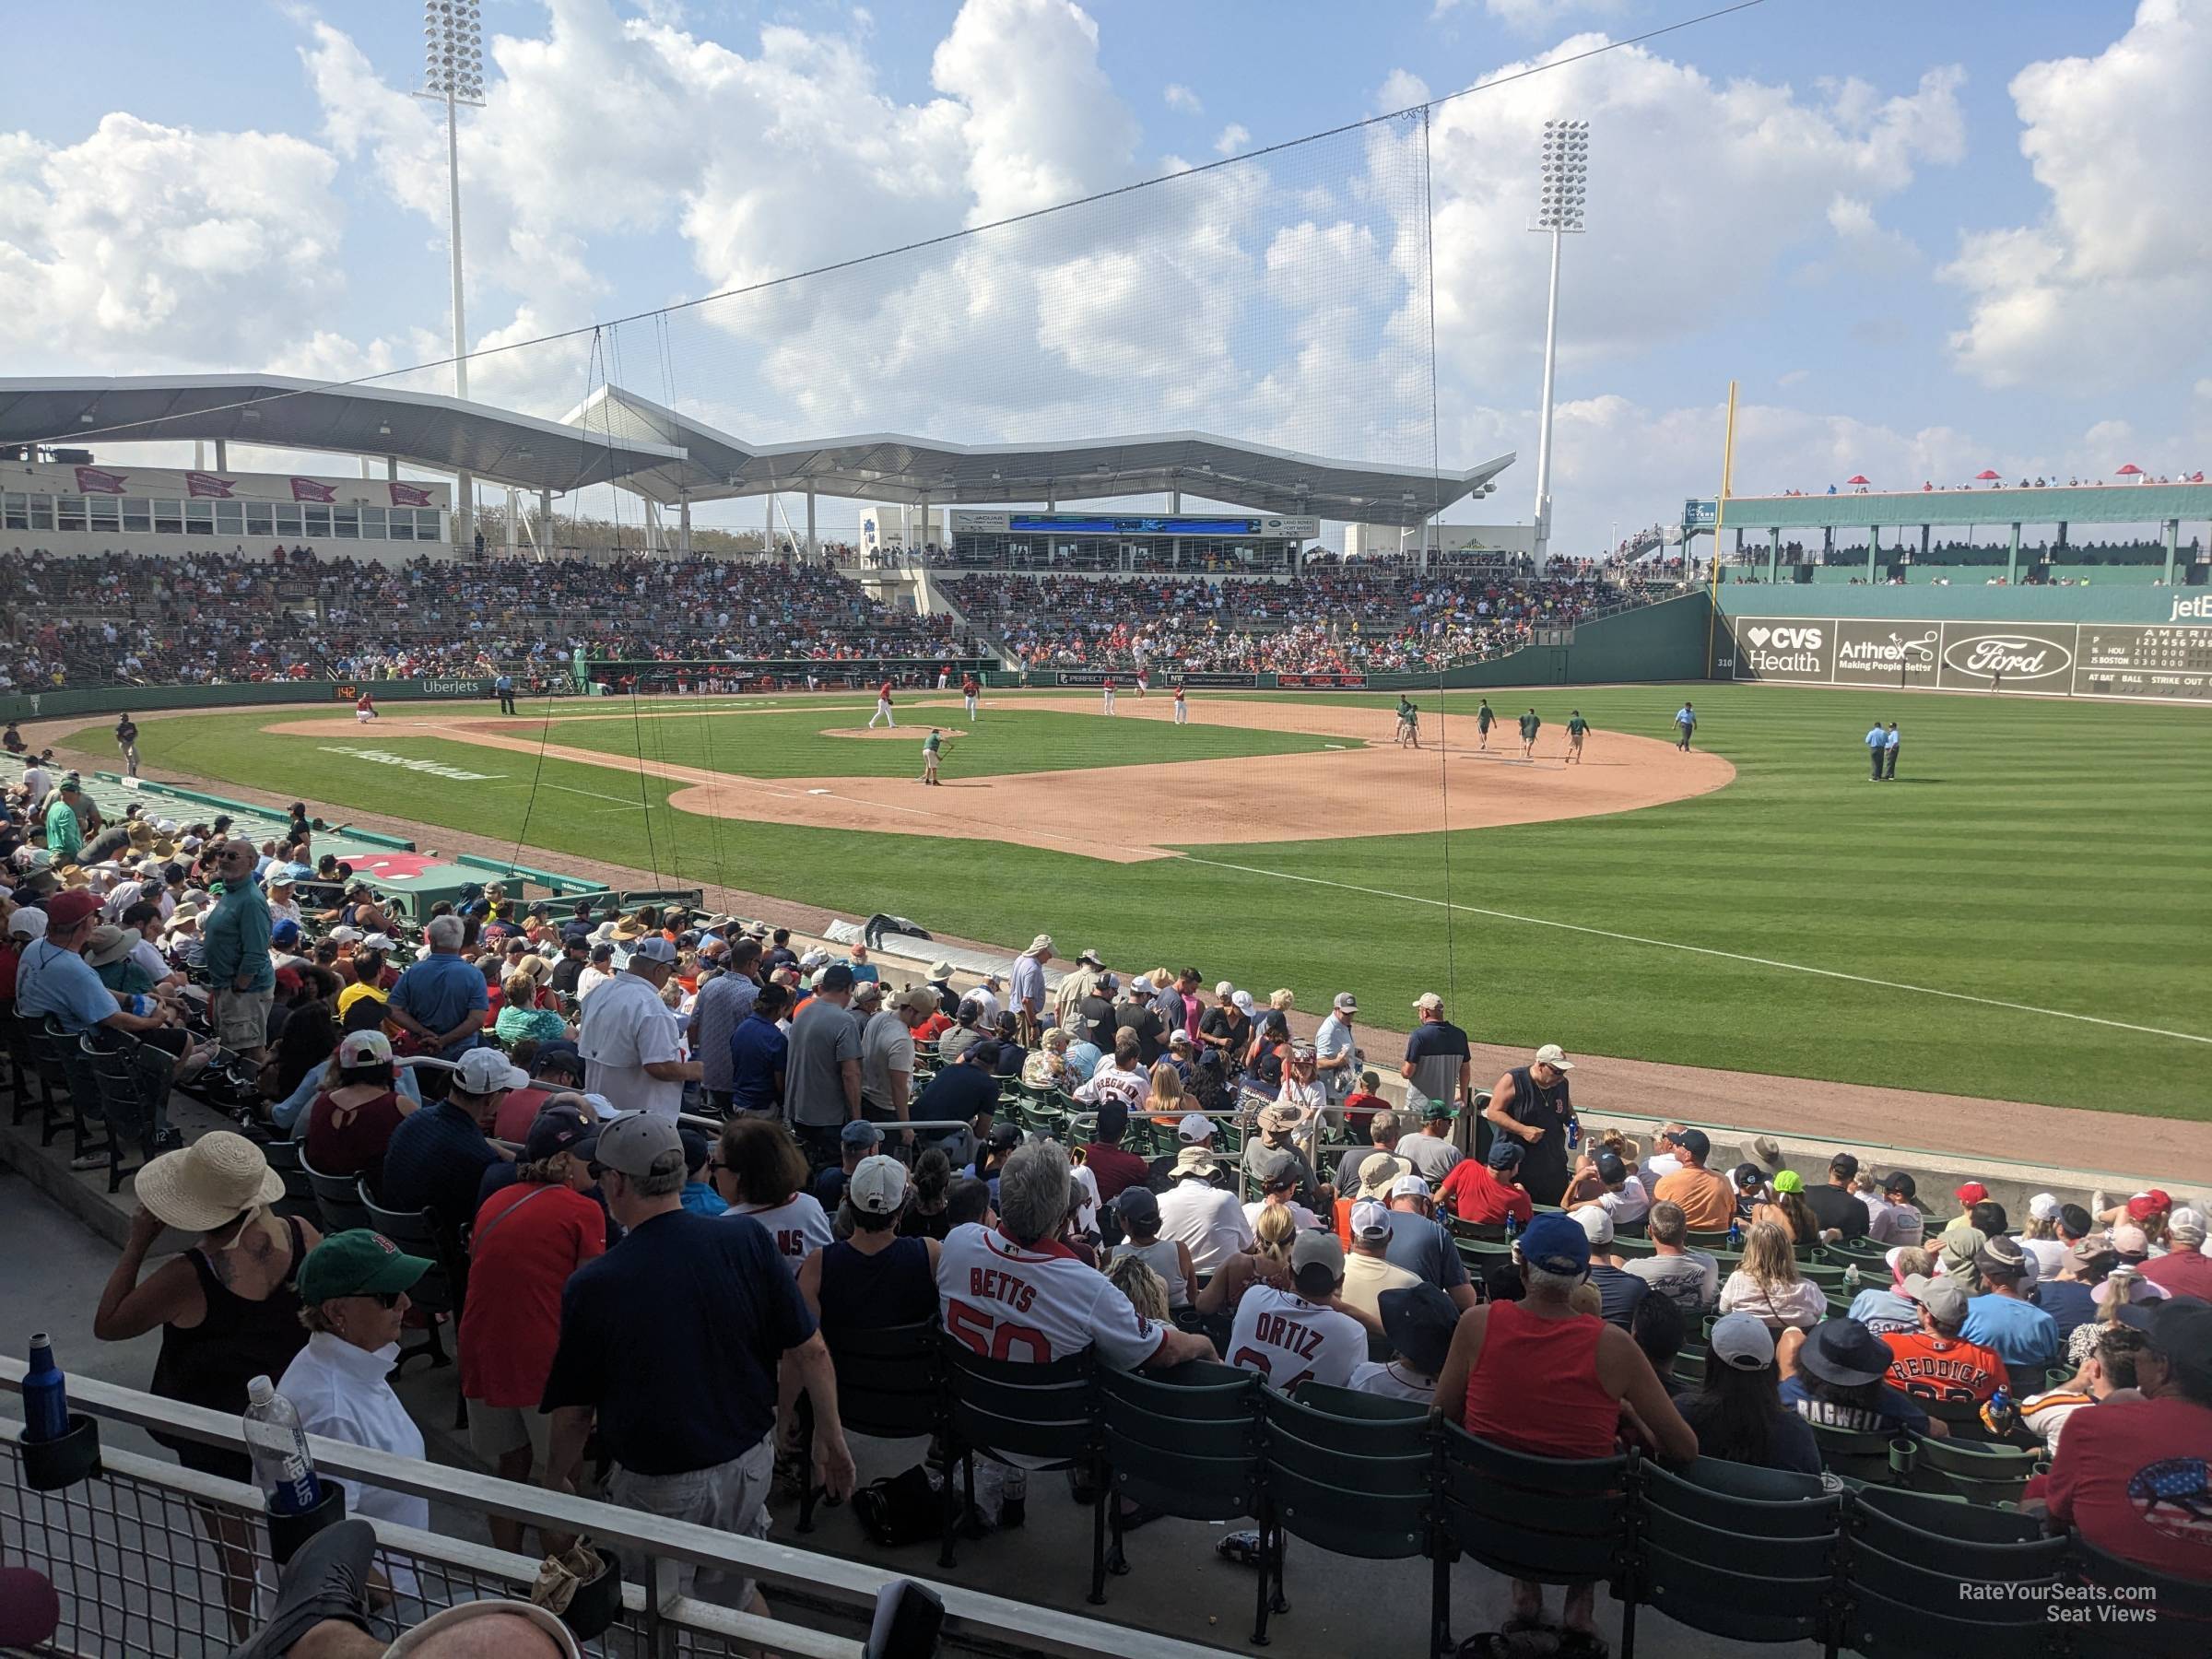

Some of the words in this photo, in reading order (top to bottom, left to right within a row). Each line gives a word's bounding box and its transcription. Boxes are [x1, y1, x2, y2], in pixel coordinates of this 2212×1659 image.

[1771, 627, 1822, 650] CVS
[1748, 650, 1821, 673] Health
[1967, 641, 2047, 673] Ford
[2107, 647, 2125, 655] HOU
[1717, 659, 1733, 667] 310
[1839, 661, 1870, 672] Making
[1872, 662, 1902, 673] People
[1904, 663, 1933, 673] Better
[423, 679, 479, 694] UberJets
[2100, 674, 2115, 682] BAT
[2122, 675, 2143, 683] BALL
[2150, 677, 2181, 685] STRIKE
[2183, 677, 2203, 686] OUT
[1096, 1077, 1139, 1100] BREGMAN
[156, 1131, 167, 1143] 12
[970, 1266, 1038, 1313] BETTS
[1254, 1312, 1324, 1362] ORTIZ
[1891, 1357, 1989, 1389] REDDICK
[282, 1454, 313, 1507] smart
